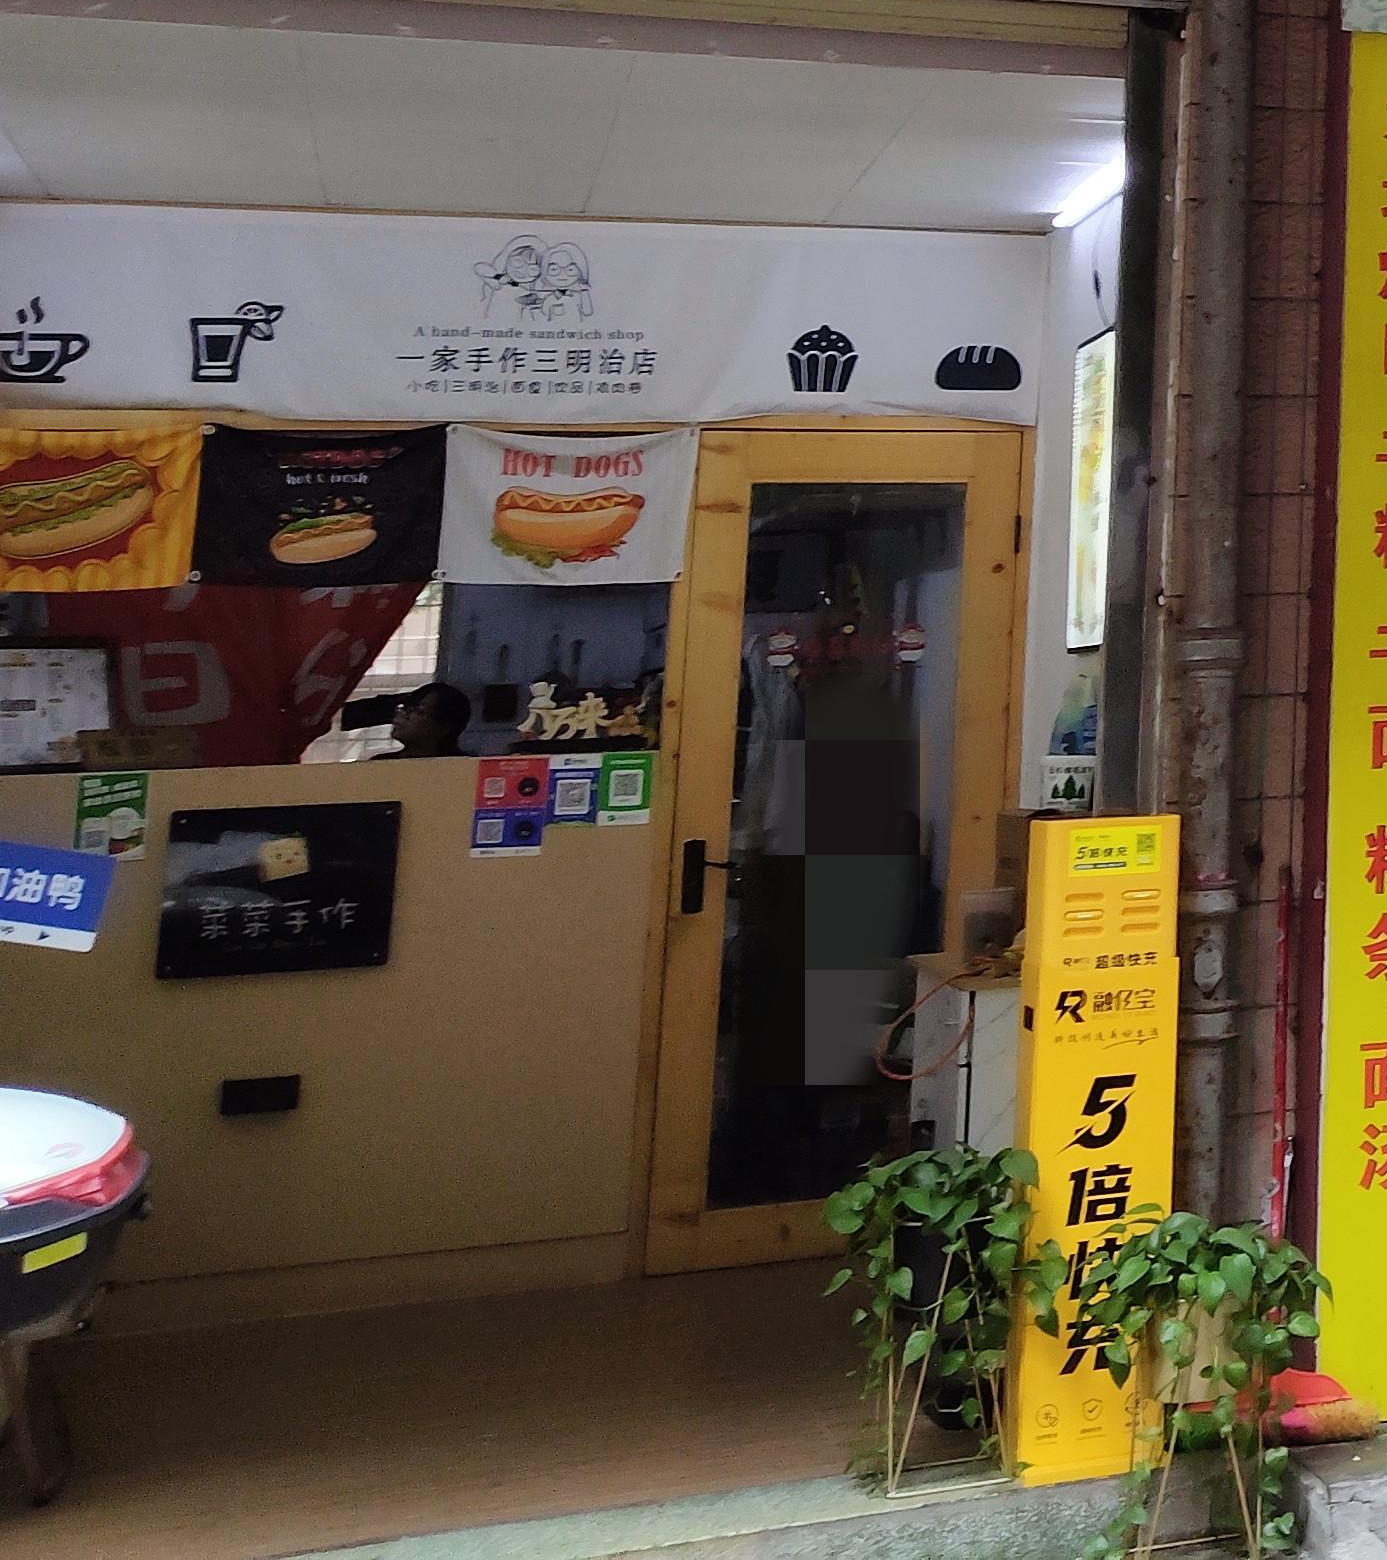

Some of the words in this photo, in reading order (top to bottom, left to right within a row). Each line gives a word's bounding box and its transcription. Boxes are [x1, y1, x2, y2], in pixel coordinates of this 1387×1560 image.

[413, 326, 425, 338] A
[431, 326, 523, 339] hand-made
[529, 327, 602, 340] sandwich
[607, 327, 645, 342] shop
[395, 345, 659, 376] 一家手作三明治店
[501, 448, 556, 477] HOT
[573, 449, 645, 478] DOGS
[199, 897, 360, 939] 菜菜手作
